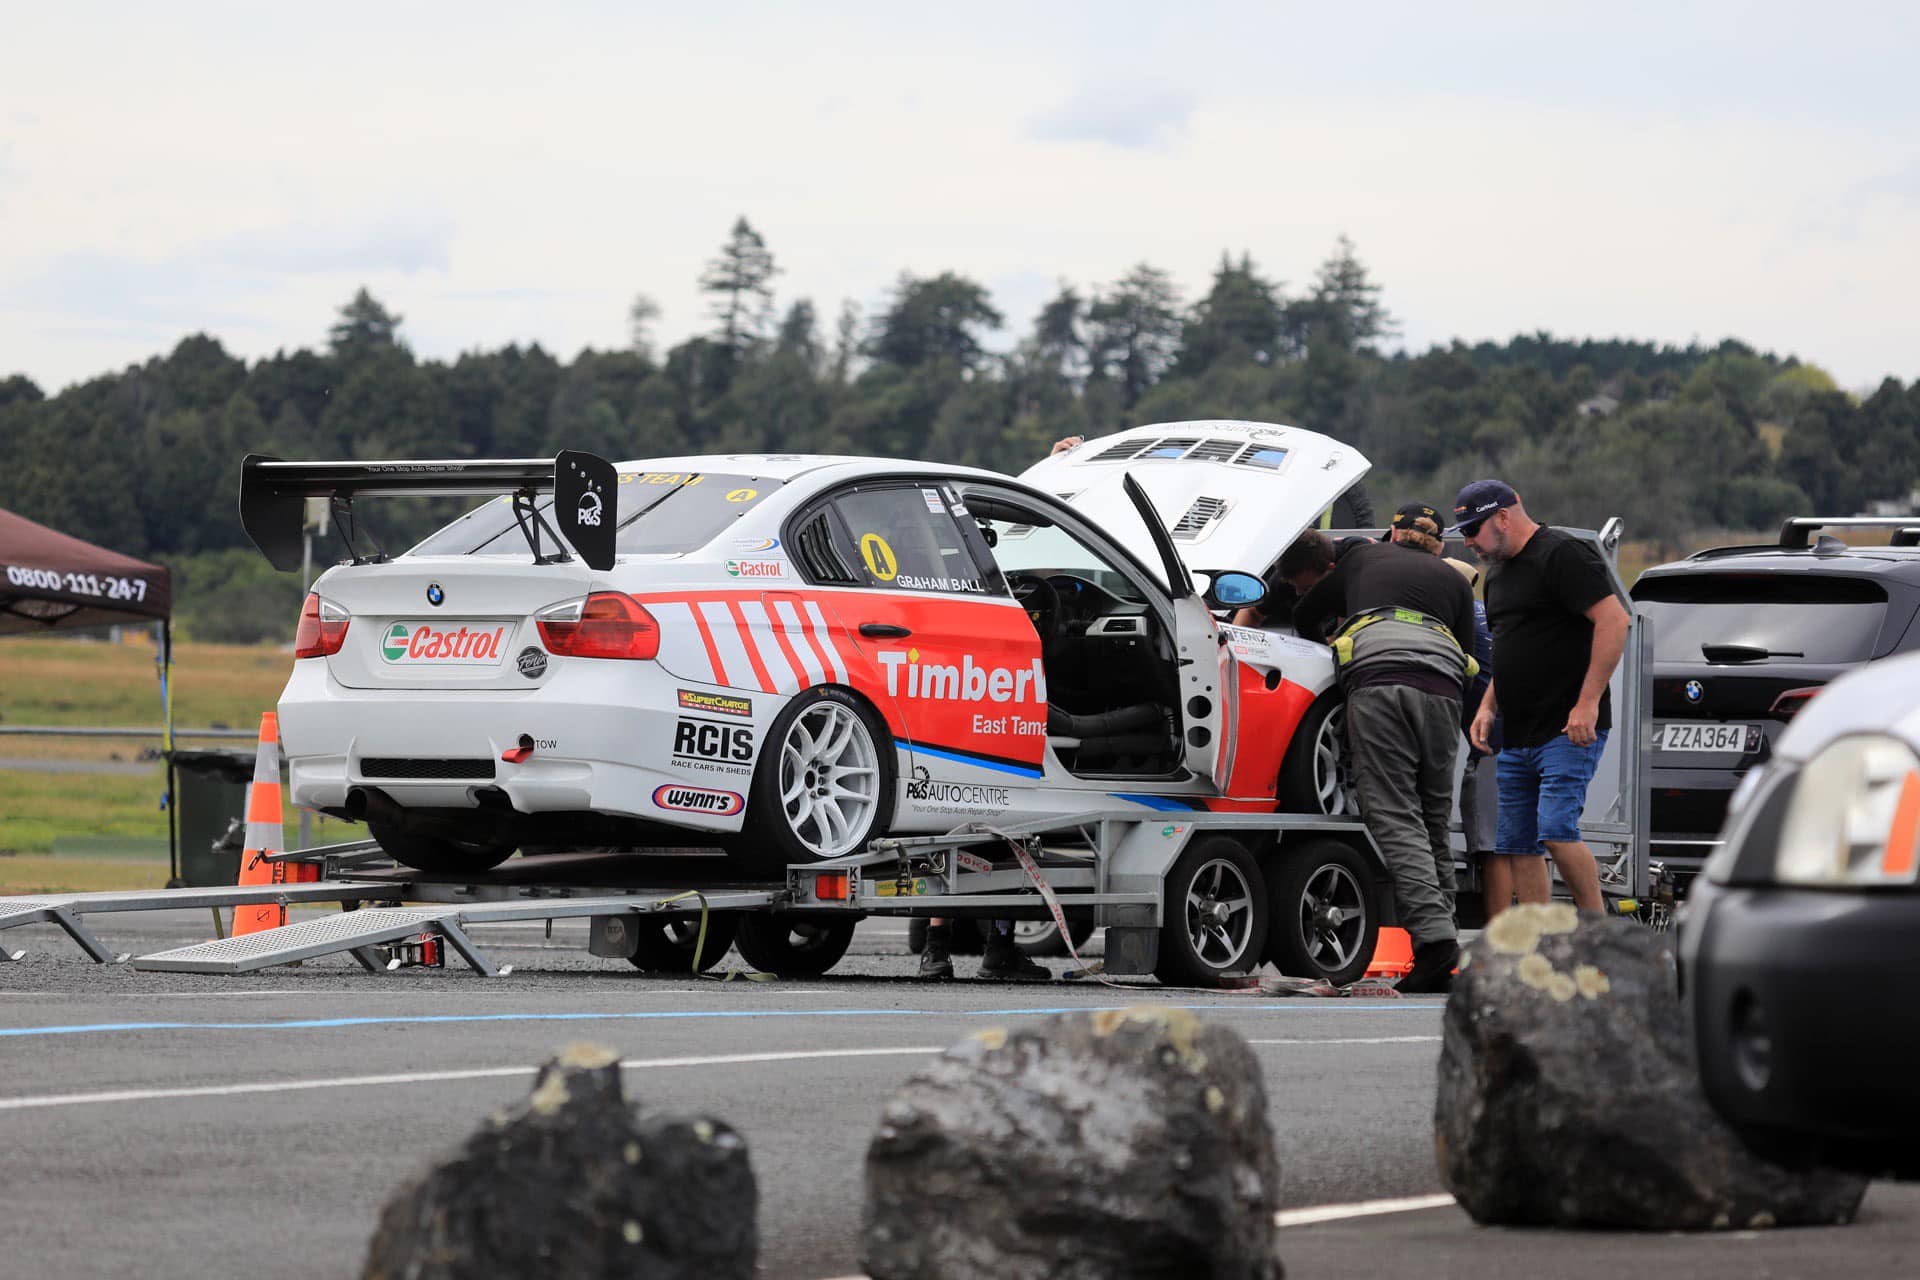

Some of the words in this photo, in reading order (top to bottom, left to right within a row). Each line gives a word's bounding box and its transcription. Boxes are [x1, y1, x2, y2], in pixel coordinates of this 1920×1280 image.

[577, 507, 602, 526] P&S
[739, 560, 783, 578] Castrol
[896, 574, 950, 591] GRAHAM
[951, 578, 985, 593] BALL
[408, 625, 504, 660] Castrol
[972, 713, 1008, 735] East
[535, 739, 557, 749] TOW
[673, 720, 754, 761] RCIS
[1668, 726, 1740, 750] ZZA364
[671, 759, 692, 769] RACE
[693, 762, 715, 772] CARS
[716, 764, 724, 773] IN
[726, 766, 752, 776] SHEDS
[926, 805, 939, 813] One
